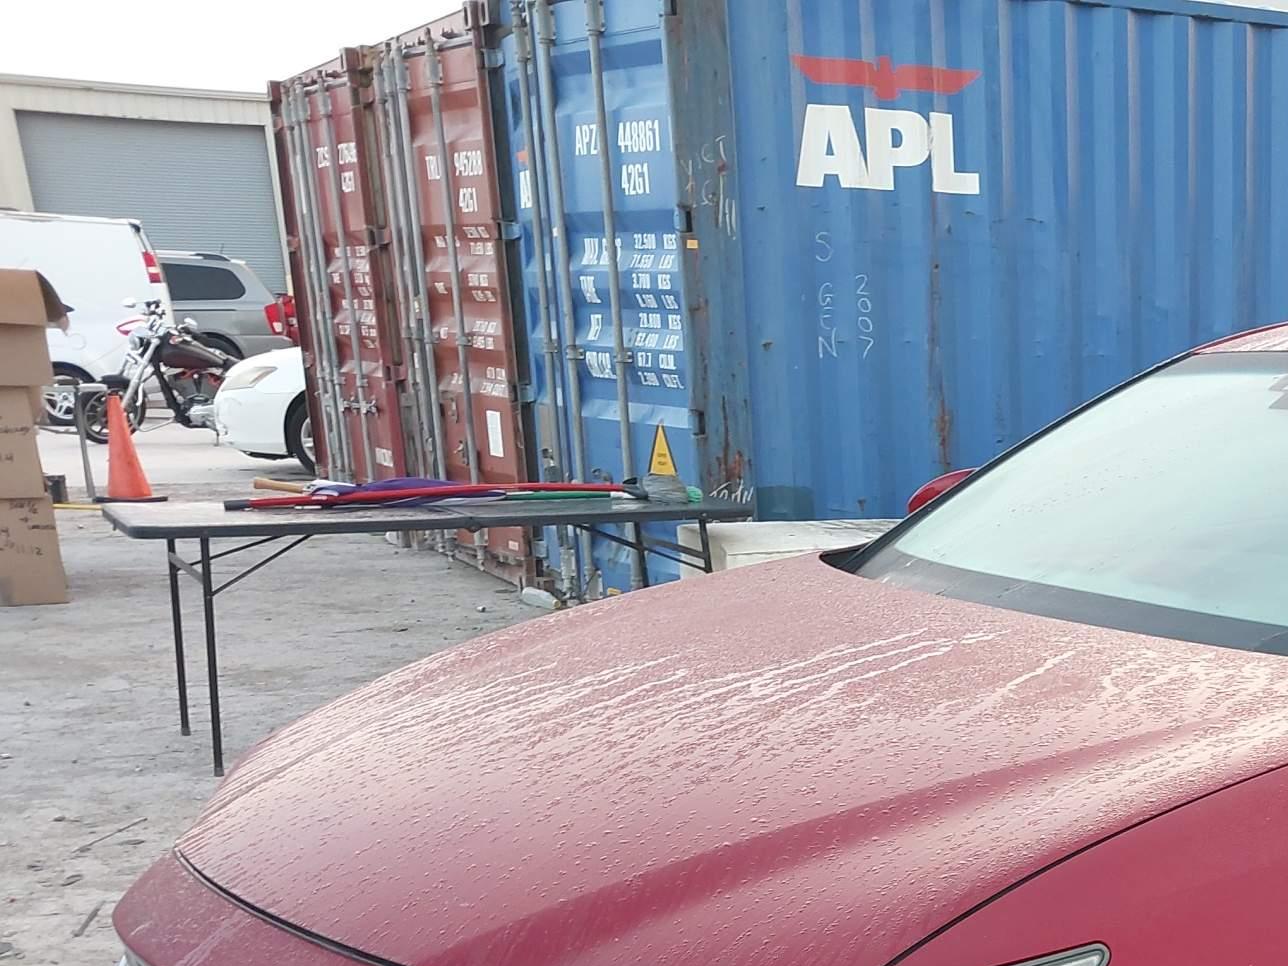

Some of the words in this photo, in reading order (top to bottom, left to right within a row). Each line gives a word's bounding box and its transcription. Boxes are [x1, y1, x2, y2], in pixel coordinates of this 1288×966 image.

[575, 124, 600, 155] APZ
[617, 120, 661, 153] 448861
[796, 104, 981, 195] APL
[425, 155, 441, 180] TRL
[621, 161, 650, 196] 42G1
